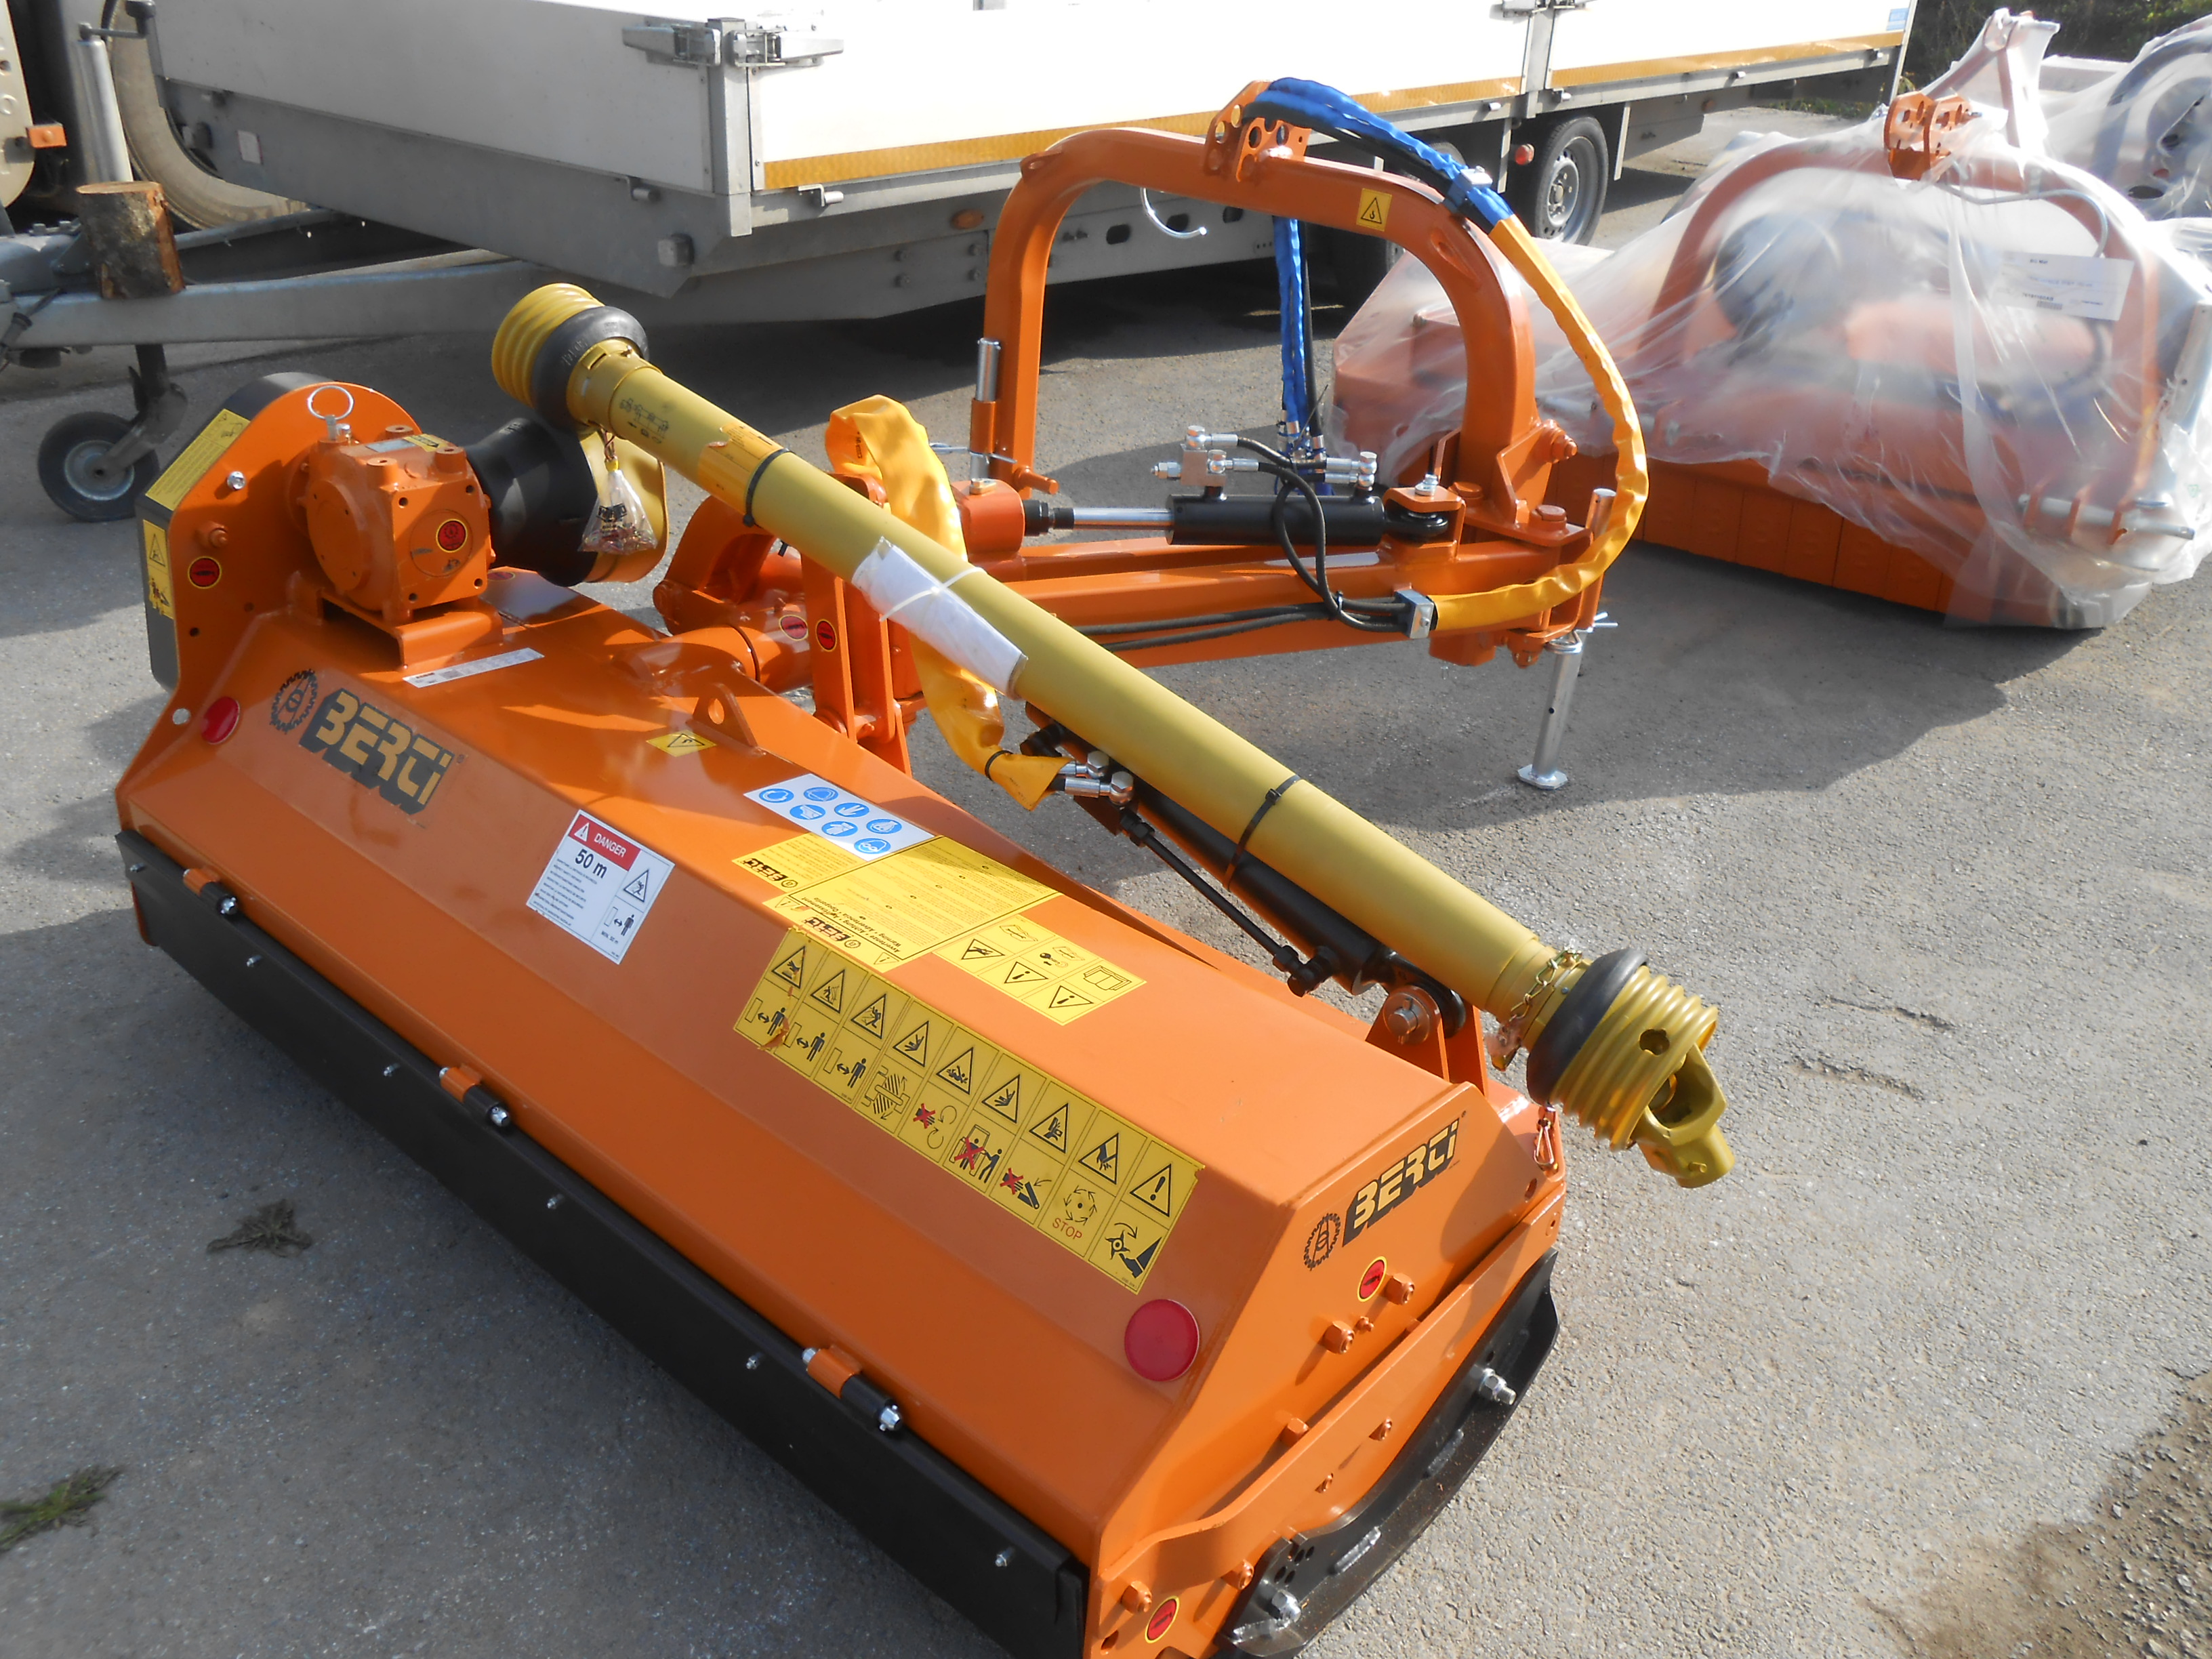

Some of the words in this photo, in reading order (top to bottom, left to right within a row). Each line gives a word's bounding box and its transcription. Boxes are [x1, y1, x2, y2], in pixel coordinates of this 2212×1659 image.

[594, 833, 627, 858] DANGER
[575, 848, 594, 869] 50
[593, 862, 608, 878] m
[800, 897, 840, 920] Artissement
[843, 920, 867, 935] Achtung
[869, 934, 901, 954] Avvertenze
[879, 933, 902, 947] Warning
[1052, 1217, 1083, 1240] STOP
